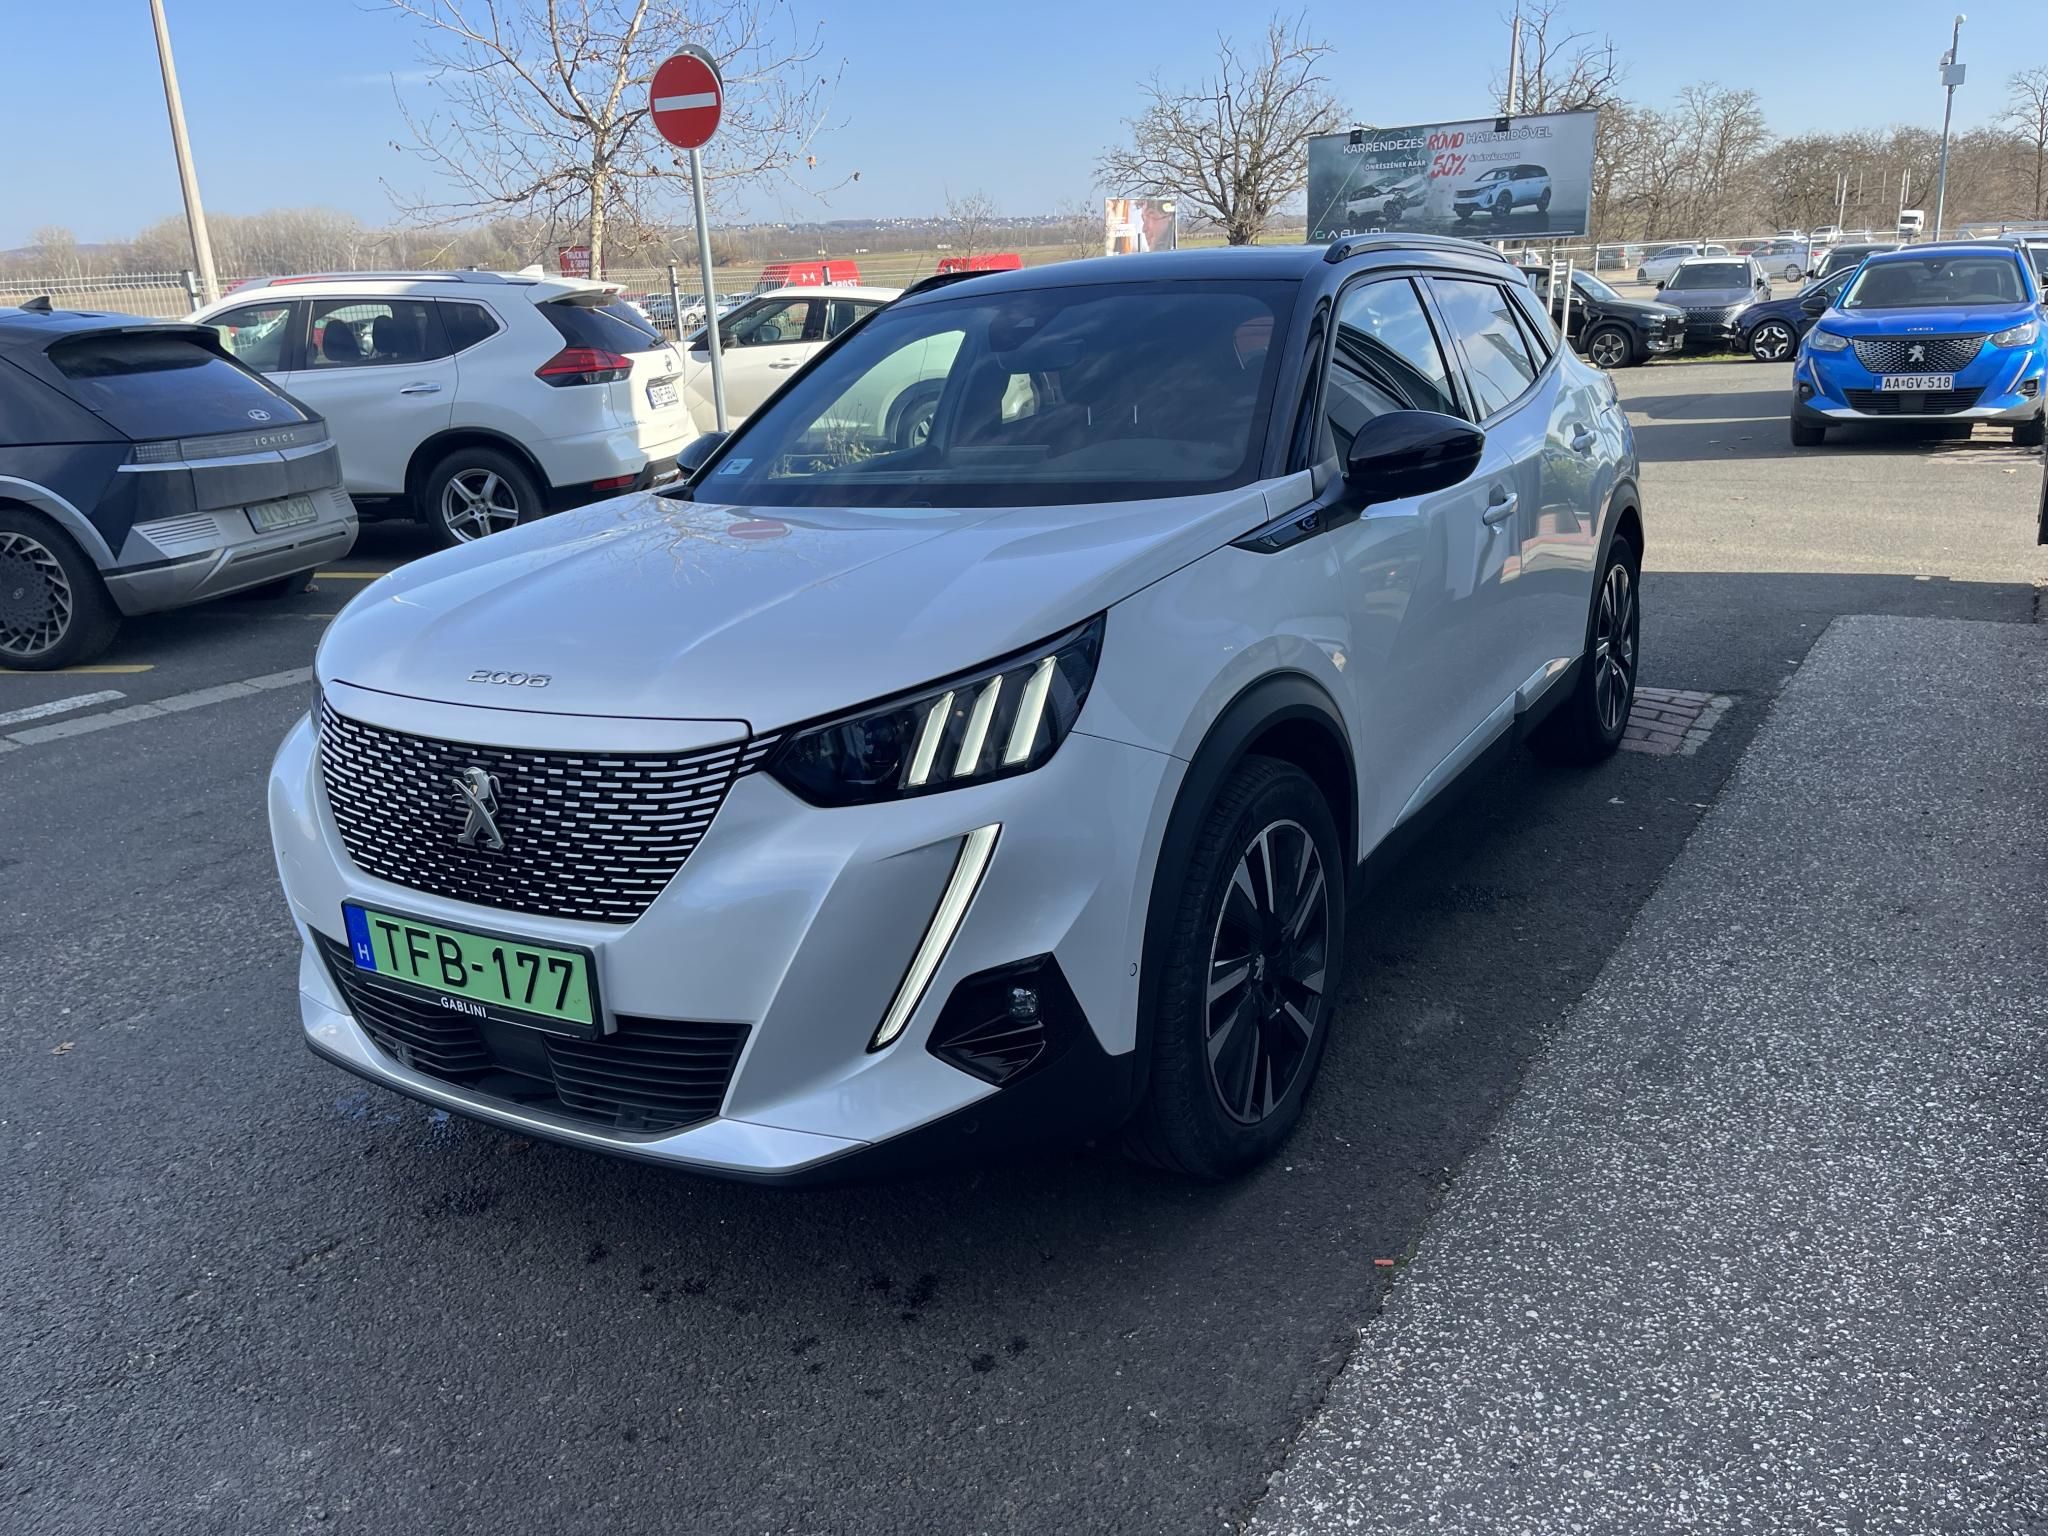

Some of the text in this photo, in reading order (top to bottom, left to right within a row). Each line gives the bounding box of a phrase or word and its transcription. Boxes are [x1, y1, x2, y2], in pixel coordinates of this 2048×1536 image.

[467, 669, 553, 688] 2008
[357, 919, 573, 1011] H TFB-177
[440, 996, 487, 1019] GABLINI
